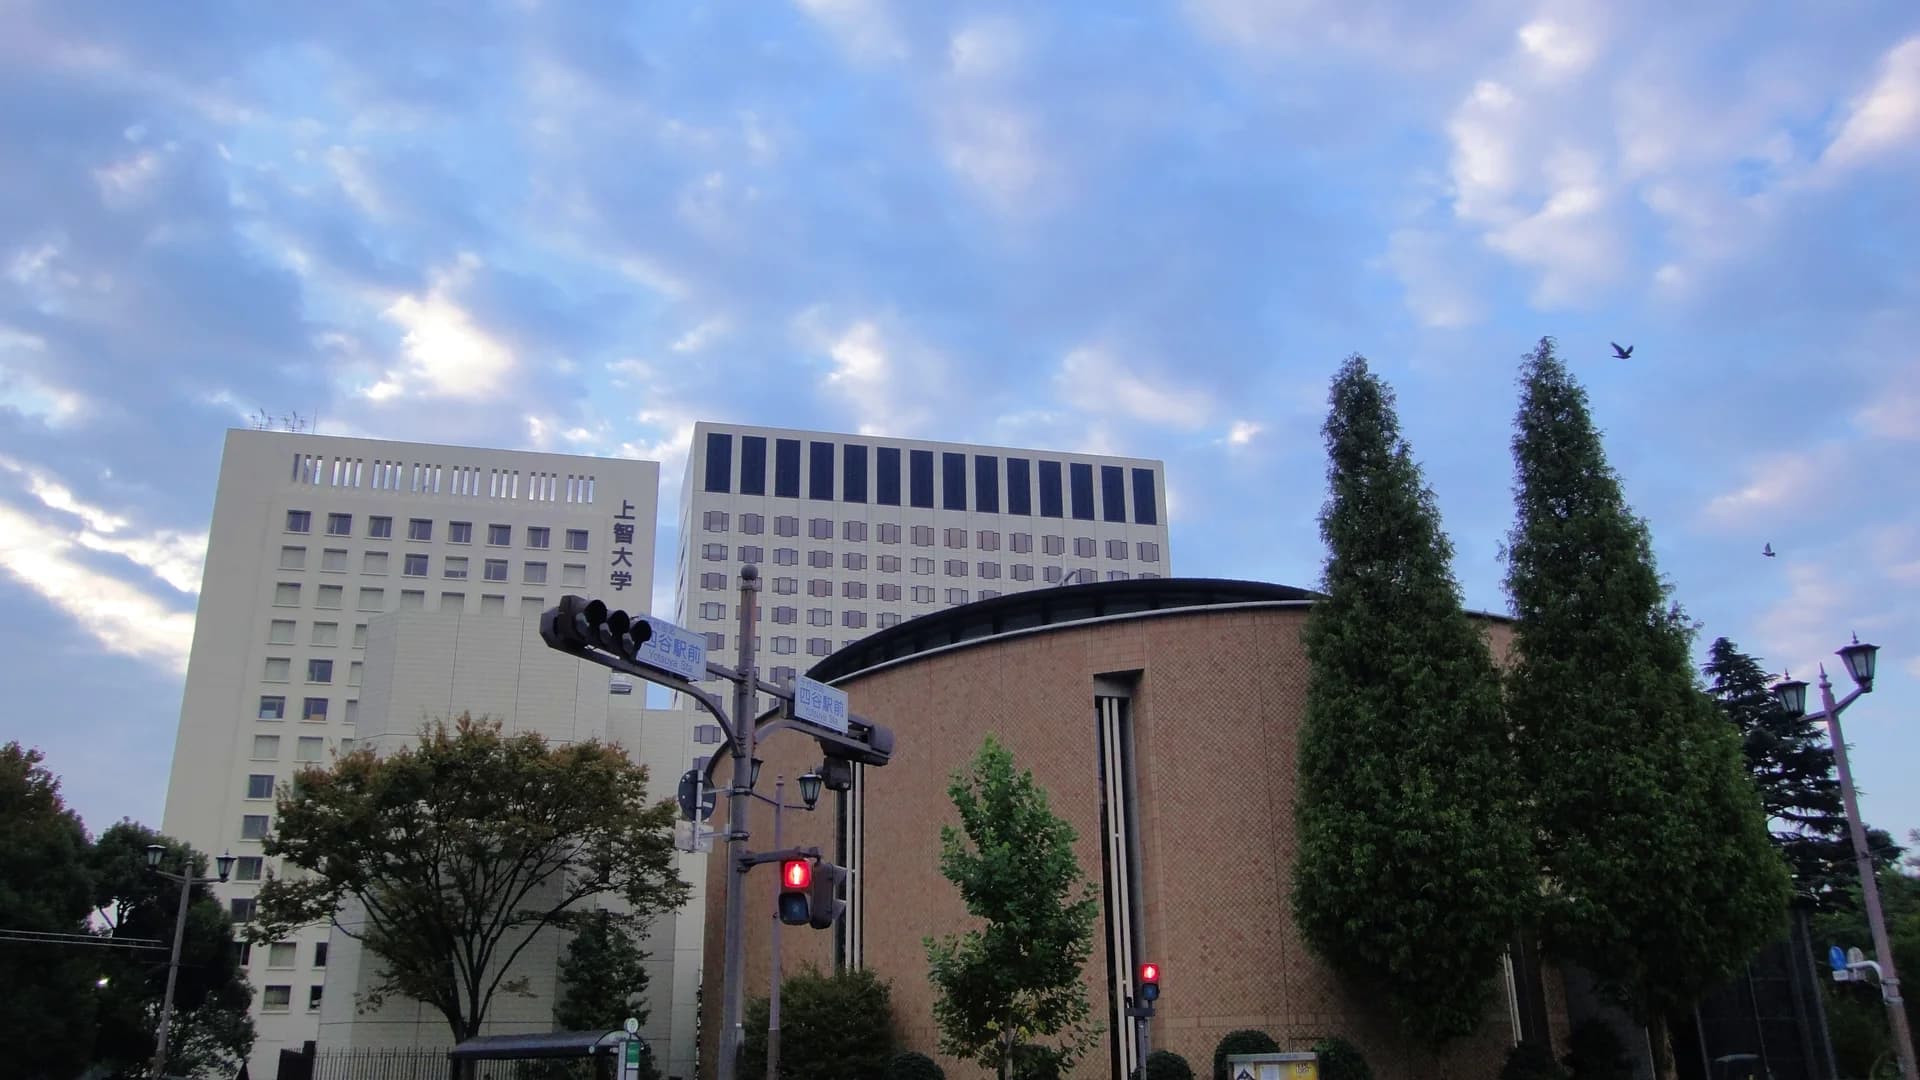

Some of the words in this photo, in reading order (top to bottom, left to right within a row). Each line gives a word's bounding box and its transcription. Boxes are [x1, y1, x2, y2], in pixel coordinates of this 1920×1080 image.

[610, 499, 635, 591] 上智大学
[800, 687, 844, 718] 四谷駅前
